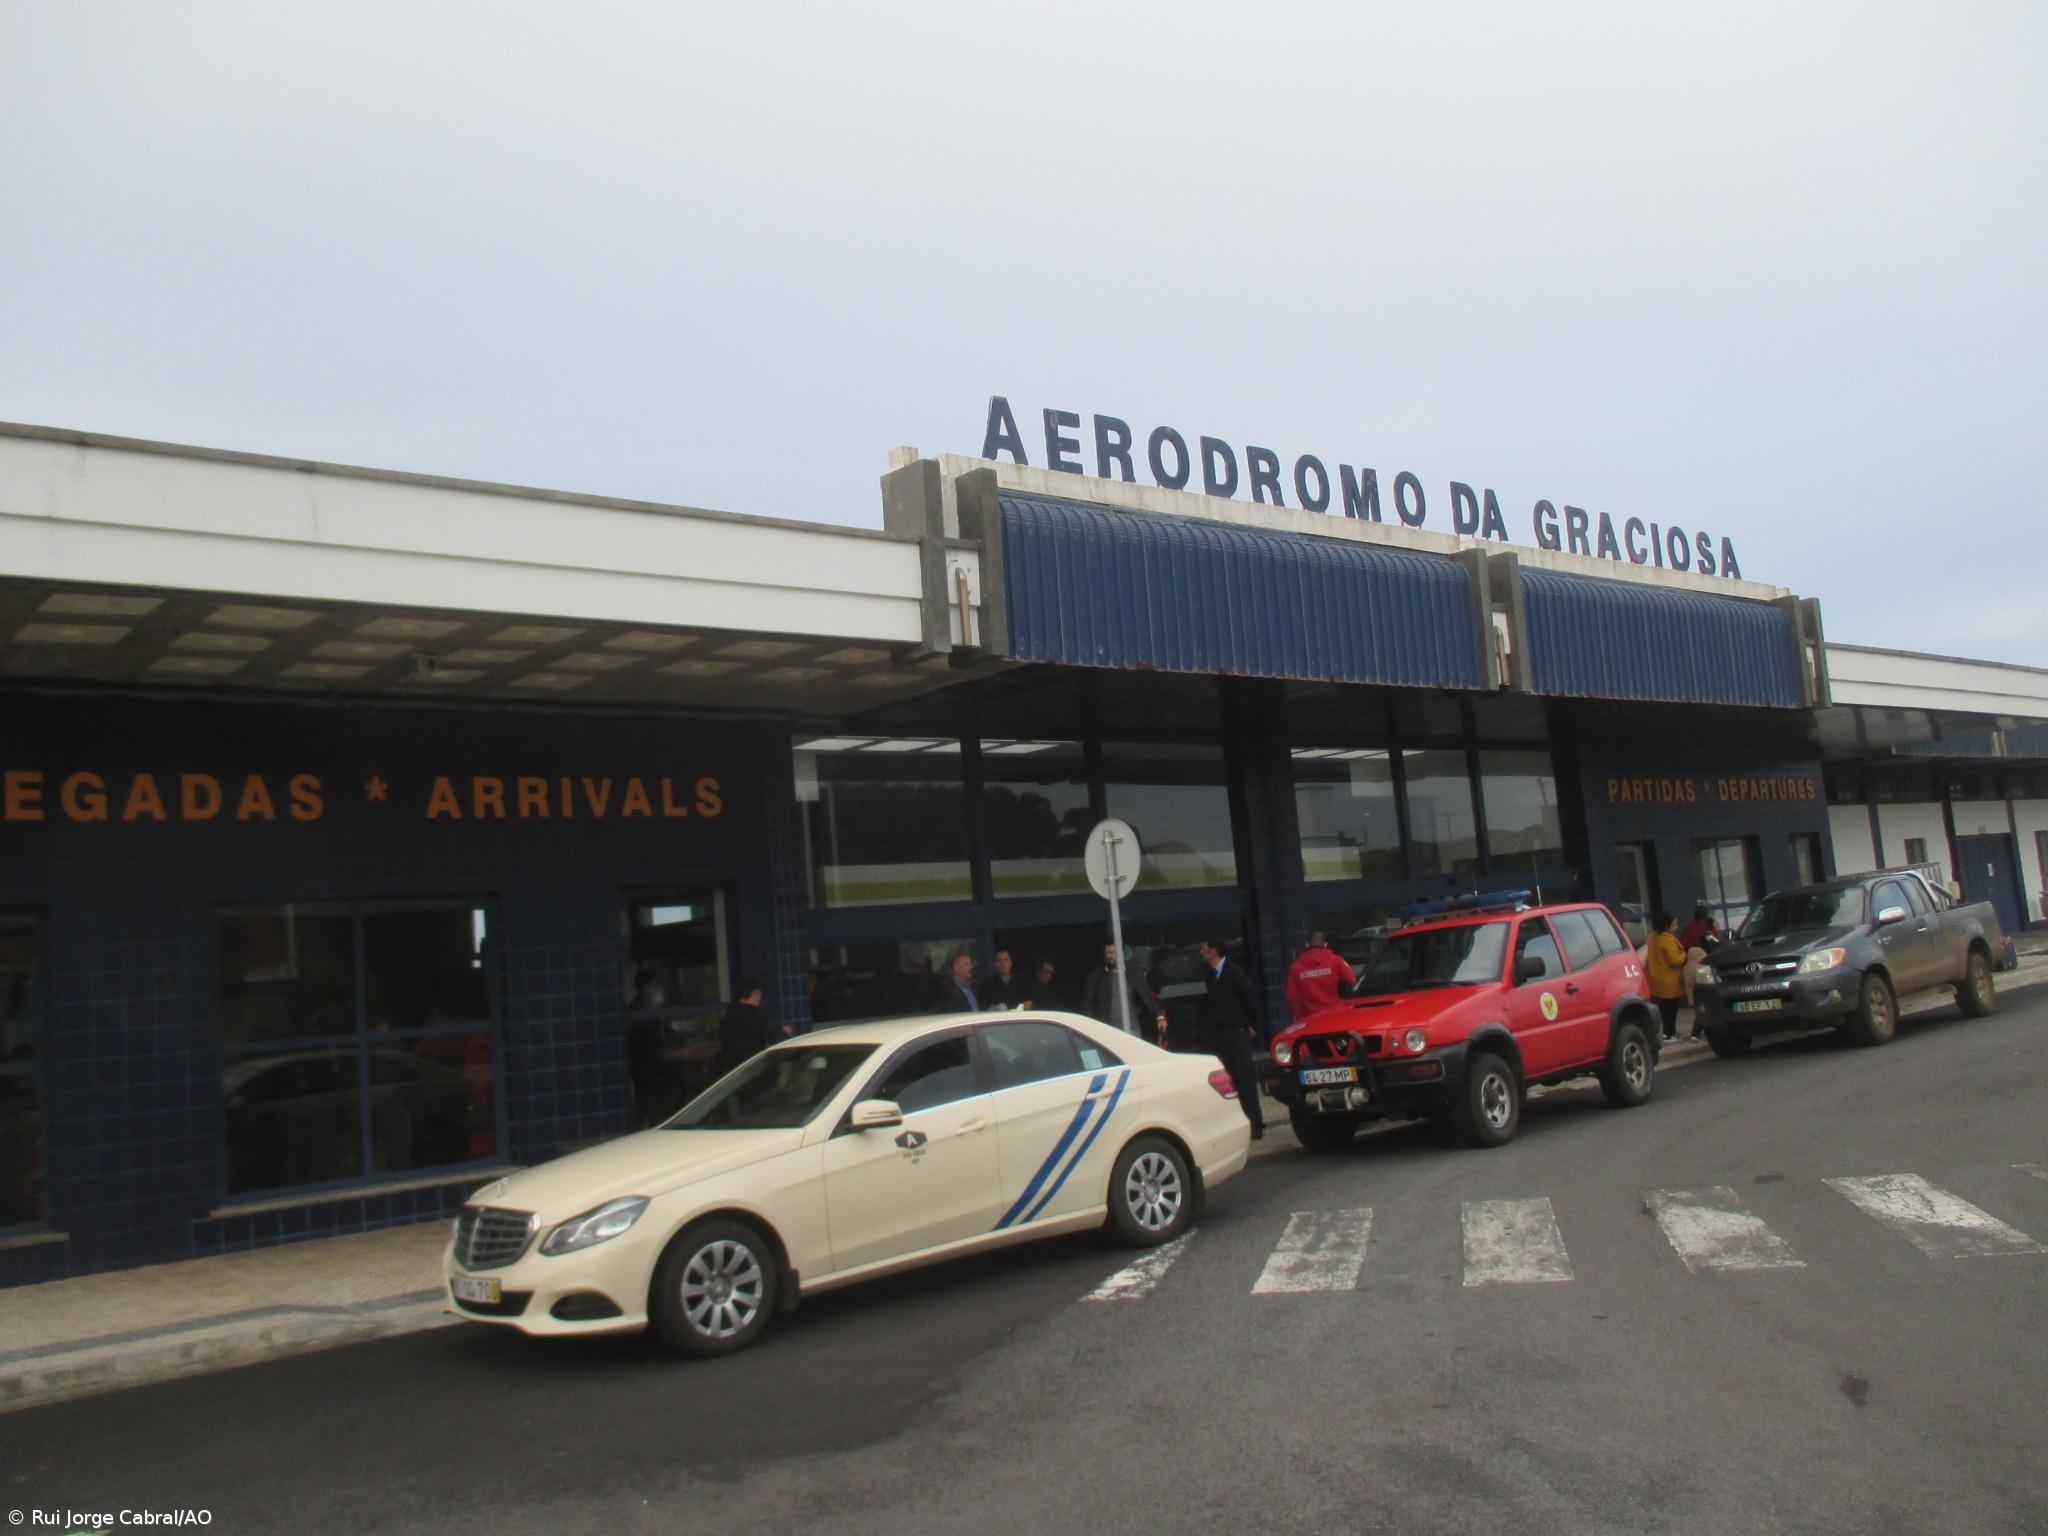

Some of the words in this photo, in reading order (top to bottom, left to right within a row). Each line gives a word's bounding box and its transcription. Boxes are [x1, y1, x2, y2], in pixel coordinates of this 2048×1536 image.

[981, 395, 1427, 527] AERODROMO
[1449, 480, 1509, 542] DA
[1532, 499, 1742, 580] GRACIOSA
[4, 770, 325, 822] EGADAS
[426, 776, 723, 818] ARRIVALS
[1607, 778, 1696, 802] PARTIDAS
[1718, 778, 1816, 800] DEPARTURES
